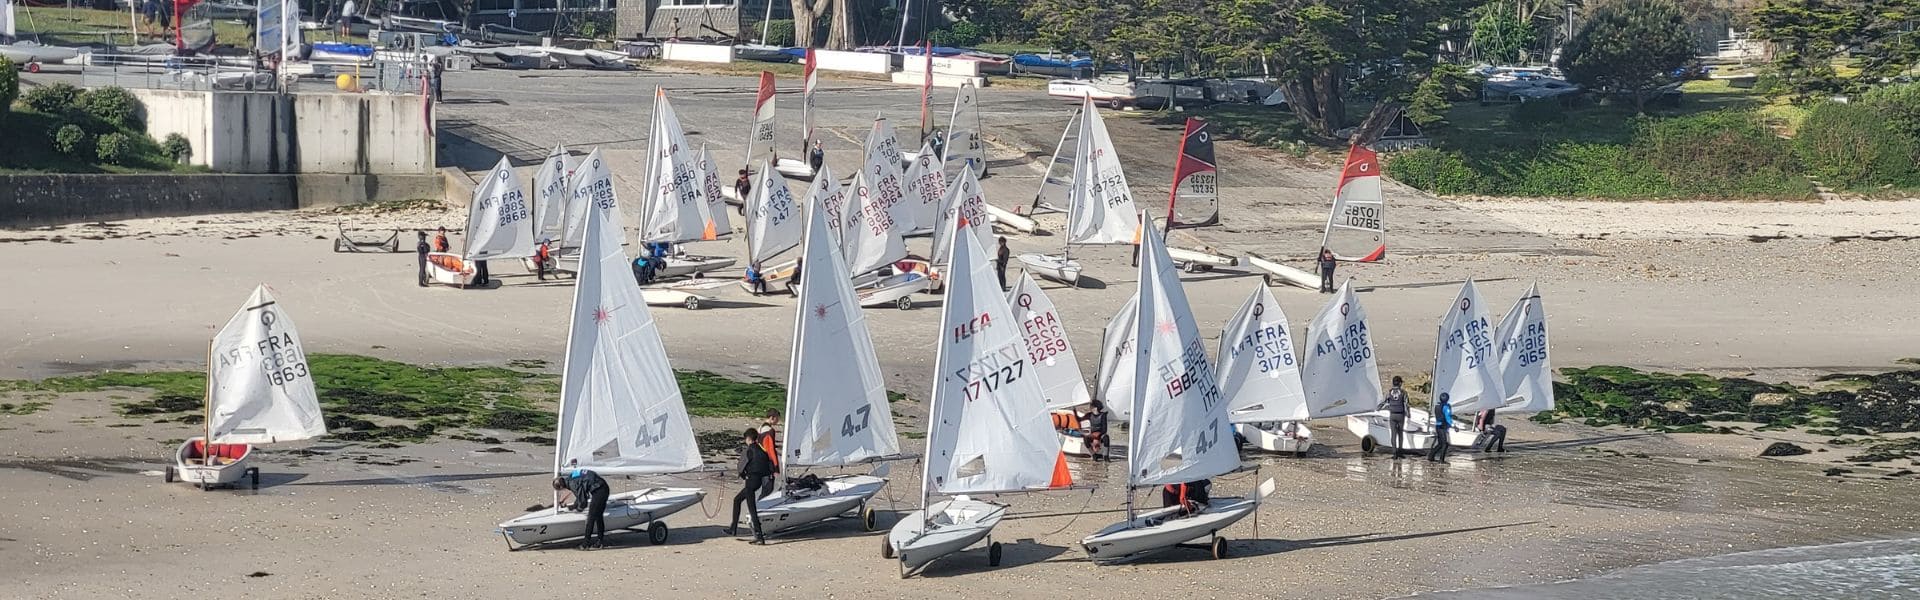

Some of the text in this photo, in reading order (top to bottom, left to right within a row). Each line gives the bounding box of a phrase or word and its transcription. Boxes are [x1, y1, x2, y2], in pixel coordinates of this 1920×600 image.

[877, 174, 896, 191] FRA
[922, 171, 942, 184] FRA
[502, 189, 523, 204] FRA
[681, 188, 702, 204] FRA
[771, 185, 788, 204] FRA
[1191, 184, 1215, 194] 13235
[824, 191, 844, 209] FRA
[864, 196, 885, 216] FRA
[963, 195, 983, 211] FRA
[1108, 192, 1129, 209] FRA
[500, 209, 527, 227] 2868
[771, 206, 790, 226] 247
[872, 215, 894, 236] 2156
[1346, 215, 1380, 229] 10785
[954, 312, 990, 345] ILCA
[1024, 311, 1057, 335] FRA
[1344, 320, 1367, 343] FRA
[1466, 316, 1488, 338] FRA
[1528, 321, 1546, 336] RA
[258, 332, 294, 356] FRA
[1255, 324, 1288, 344] FRA
[1028, 338, 1067, 366] 3259
[1258, 352, 1294, 373] 3178
[1344, 346, 1371, 373] 3060
[1466, 343, 1492, 369] 2577
[1519, 346, 1547, 367] 3165
[267, 362, 307, 387] 1663
[962, 359, 1024, 402] 171727
[1166, 353, 1208, 400] 198275
[1203, 384, 1219, 412] ITA
[635, 413, 668, 448] 4.7
[841, 403, 871, 437] 4.7
[1195, 417, 1218, 455] 4.7
[539, 524, 548, 535] 2
